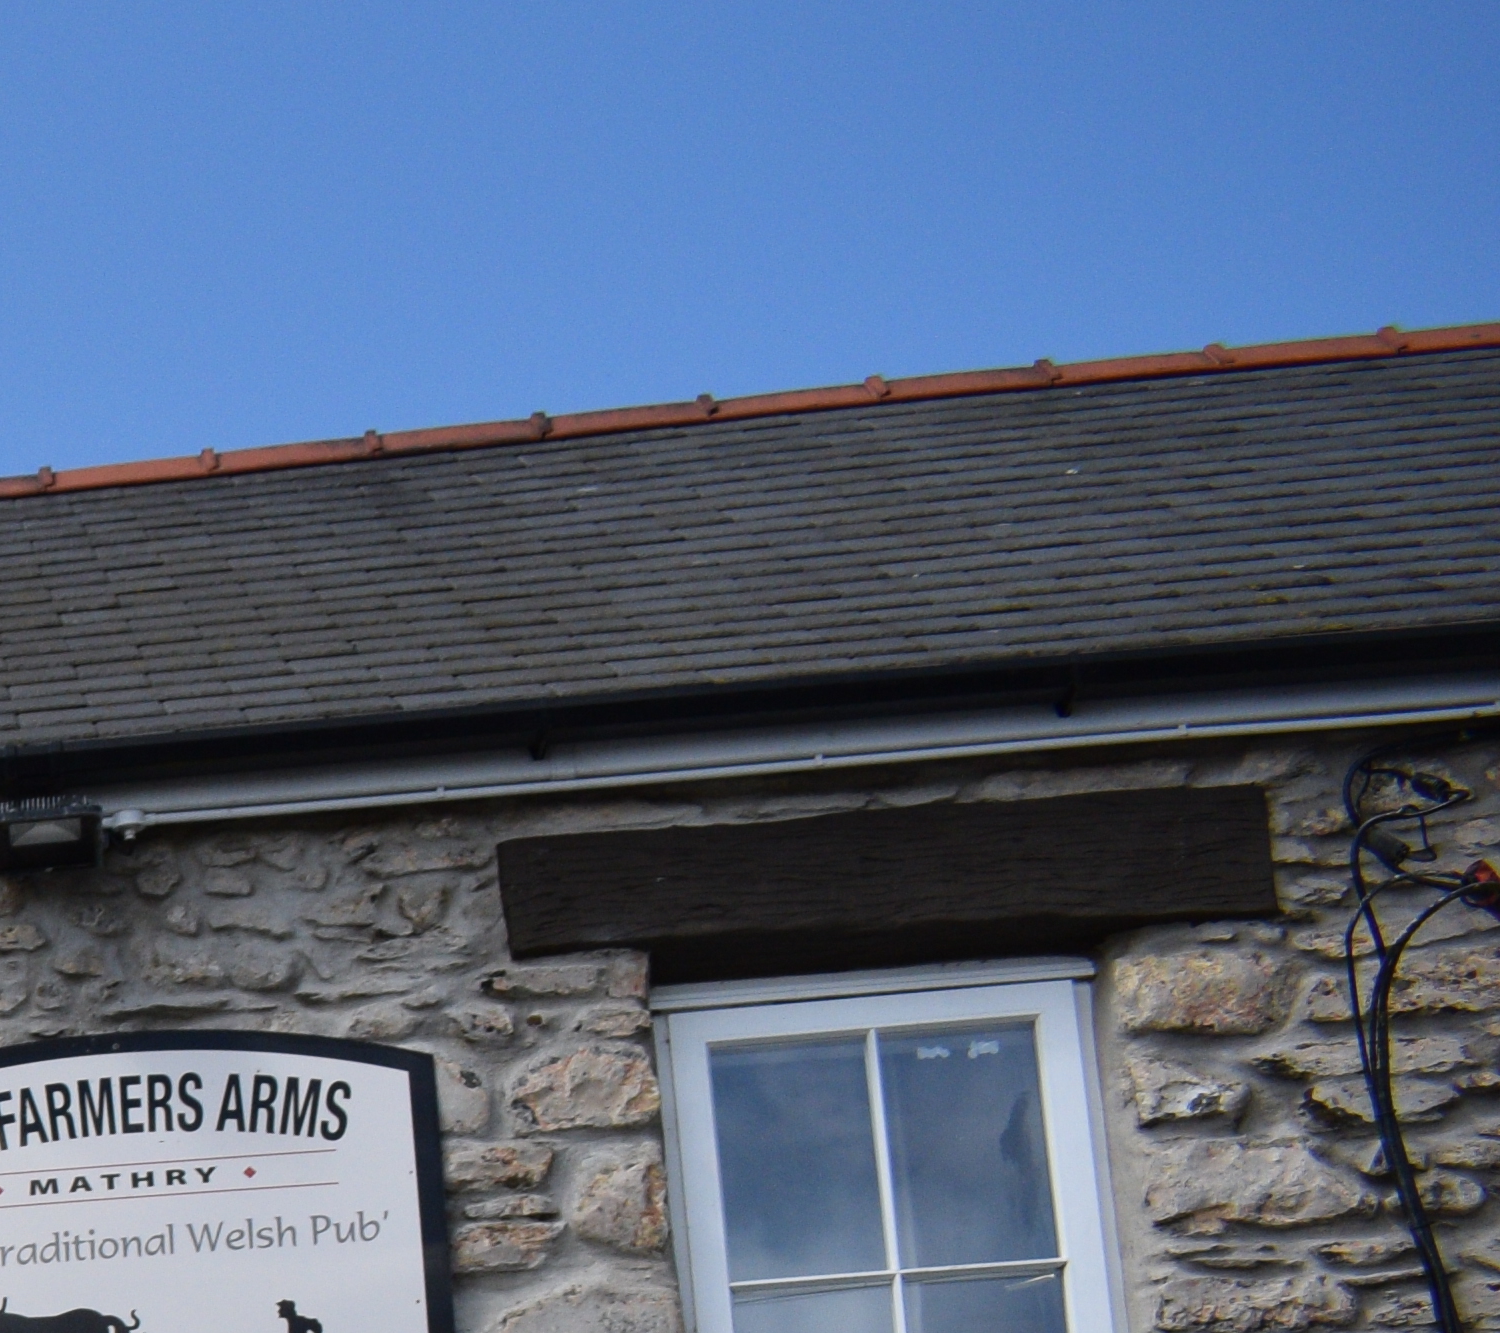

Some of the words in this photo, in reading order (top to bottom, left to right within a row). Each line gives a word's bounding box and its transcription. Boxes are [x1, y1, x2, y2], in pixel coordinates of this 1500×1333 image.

[216, 1073, 352, 1141] ARMS
[29, 1166, 217, 1196] MATHRY
[185, 1216, 298, 1253] Welsh
